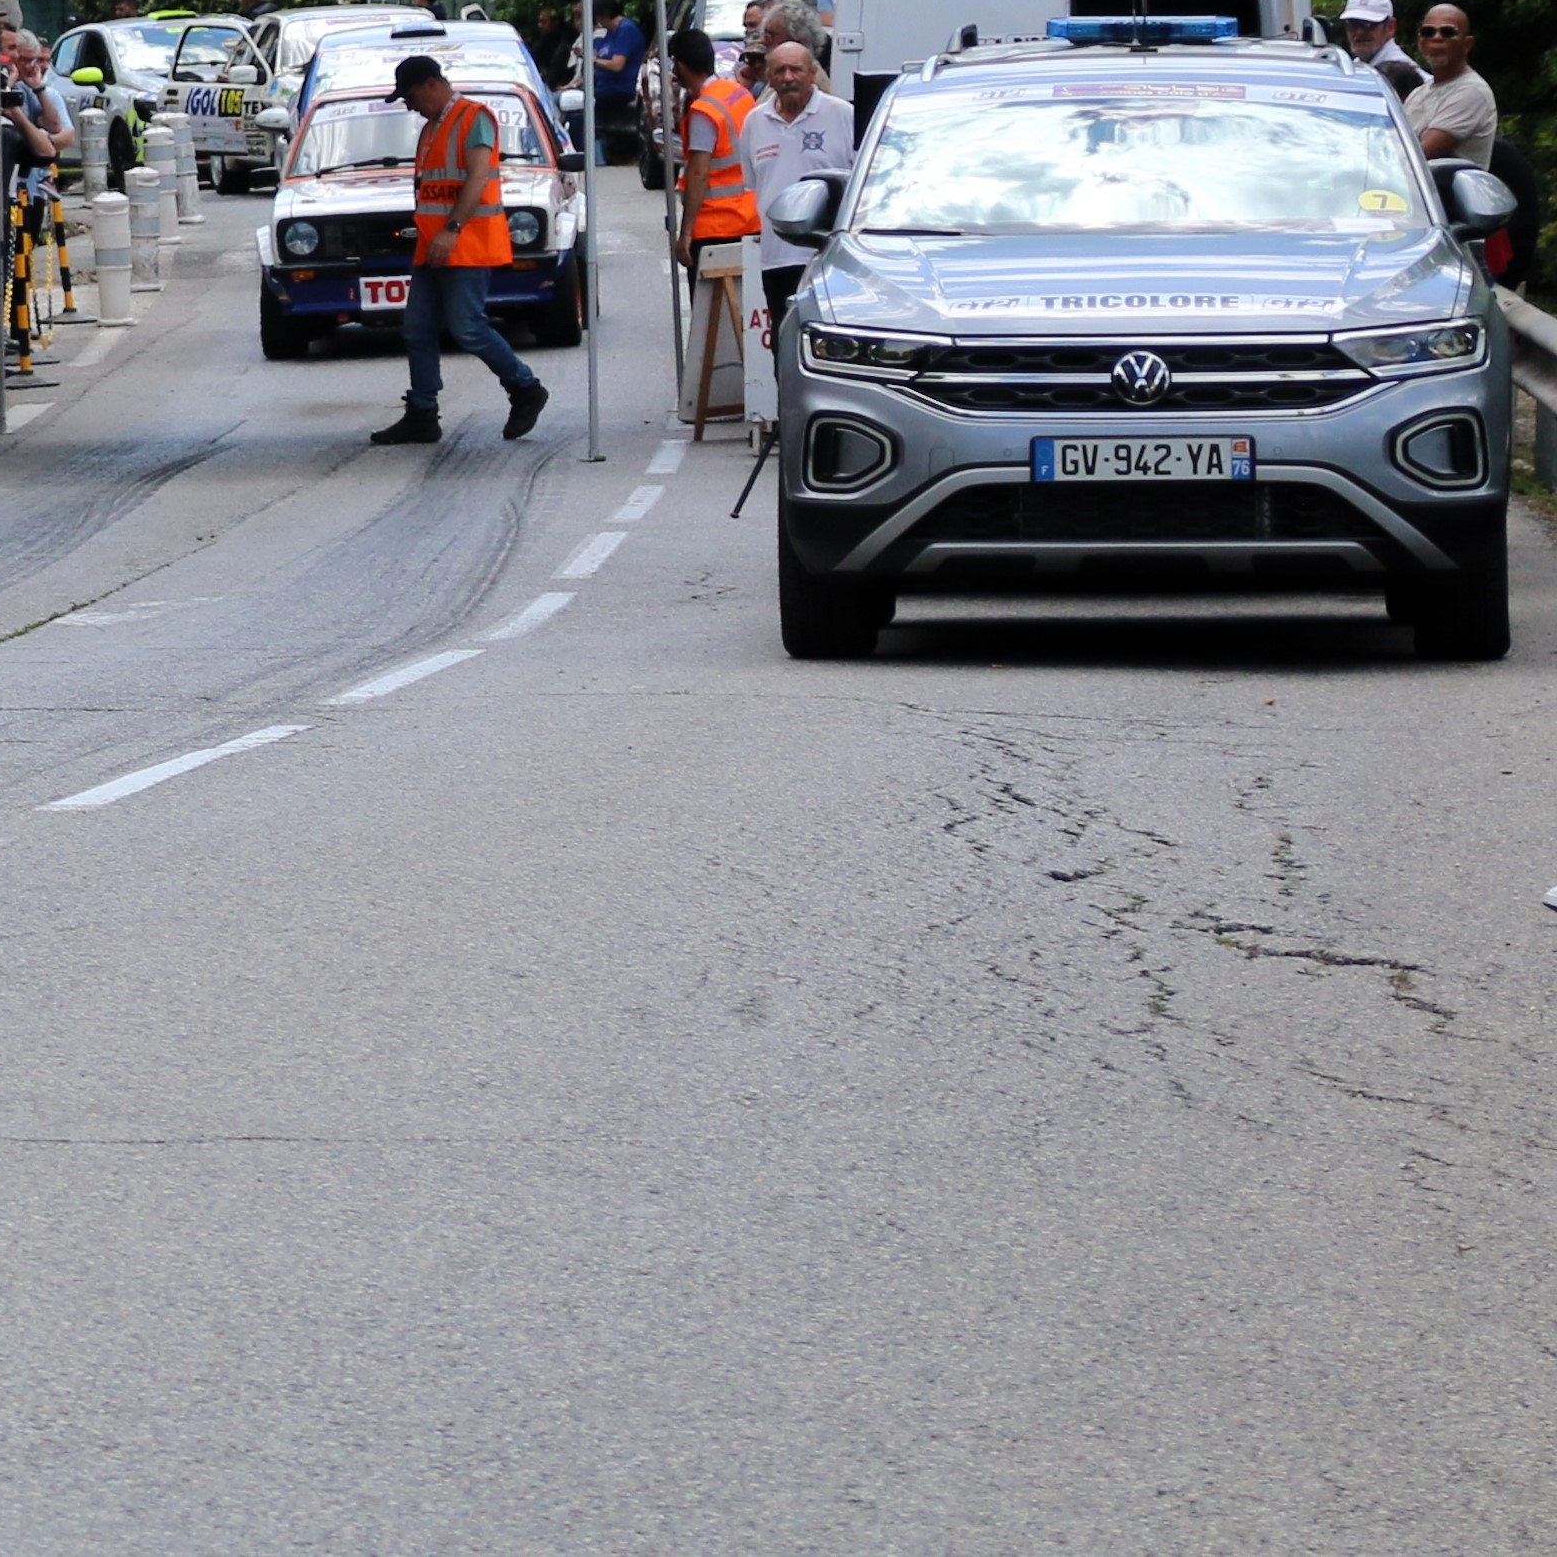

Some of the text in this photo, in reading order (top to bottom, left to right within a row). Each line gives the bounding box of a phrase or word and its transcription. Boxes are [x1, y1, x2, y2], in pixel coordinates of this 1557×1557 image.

[186, 87, 244, 116] IGOL 105
[1372, 193, 1389, 209] 7
[1040, 295, 1240, 310] TRICOLORE
[1061, 443, 1224, 476] GV-942-YA
[1041, 465, 1050, 476] F
[1232, 460, 1250, 476] 76
